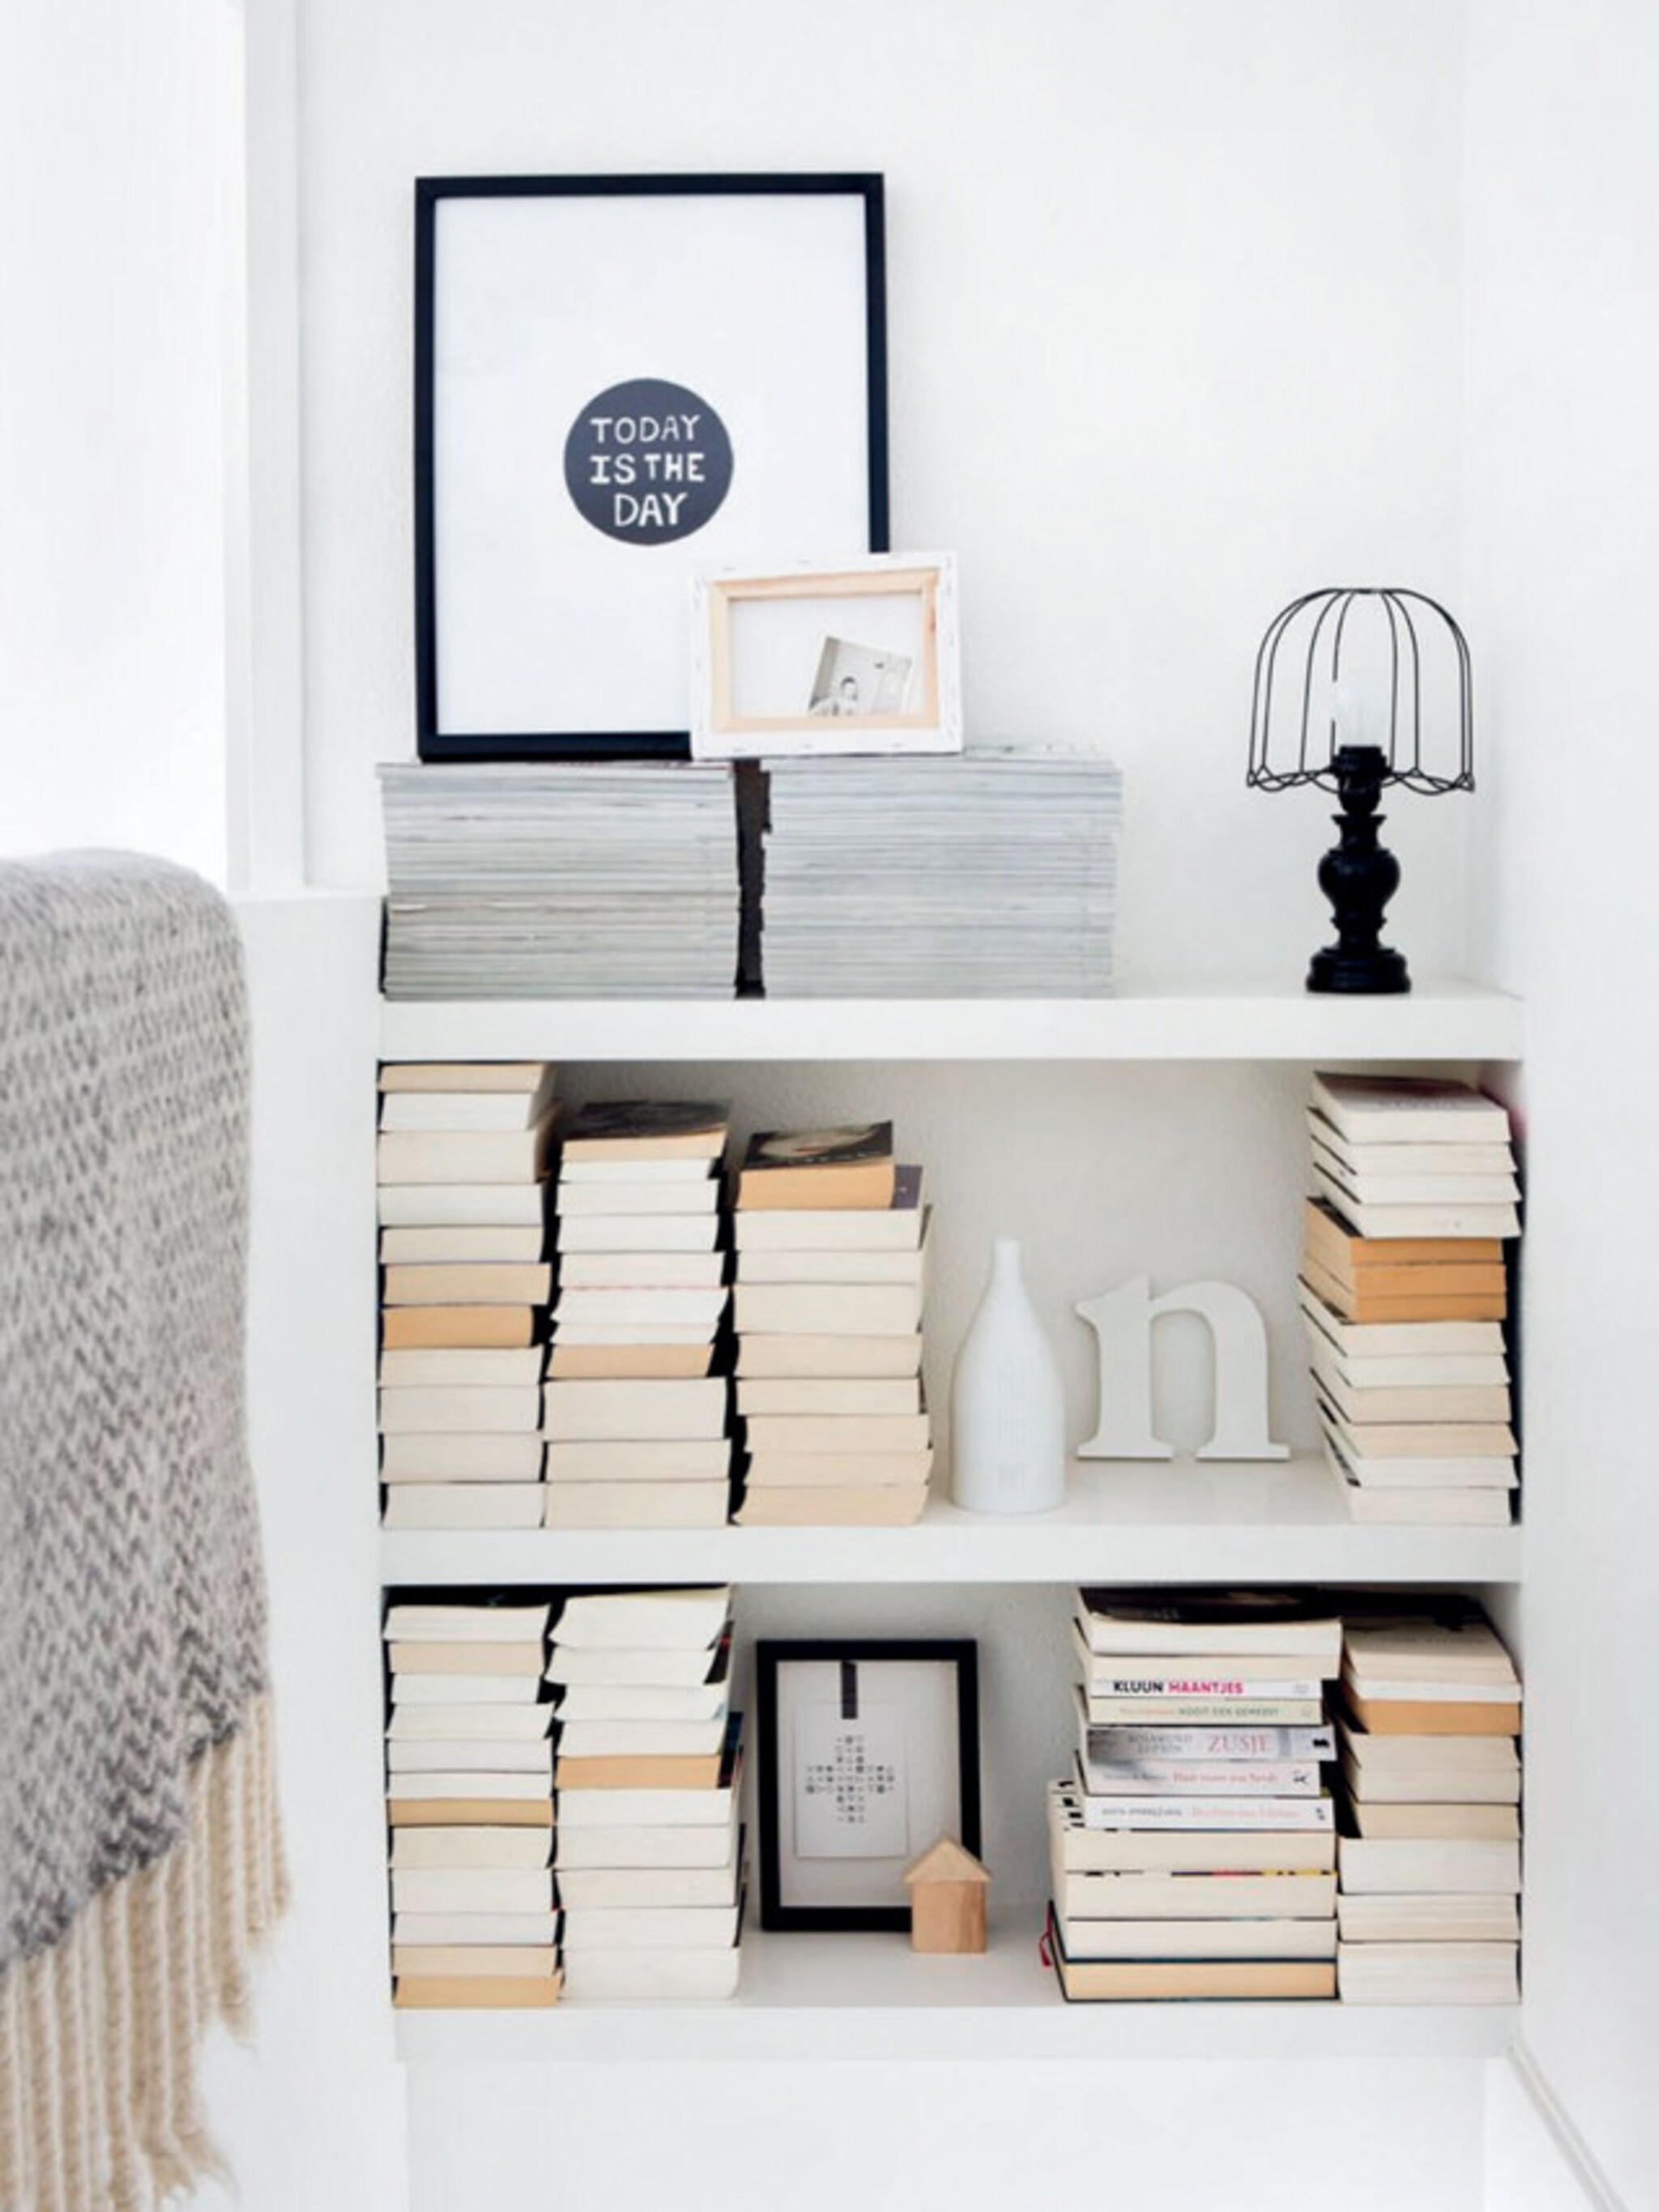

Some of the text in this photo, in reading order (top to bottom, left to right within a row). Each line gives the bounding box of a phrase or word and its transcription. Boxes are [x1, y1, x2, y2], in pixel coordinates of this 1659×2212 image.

[589, 414, 701, 444] TODAY
[589, 452, 706, 484] IS THE
[614, 492, 687, 527] DAY
[1075, 1274, 1290, 1461] n
[1113, 1681, 1244, 1694] KLUUN HAANTJES
